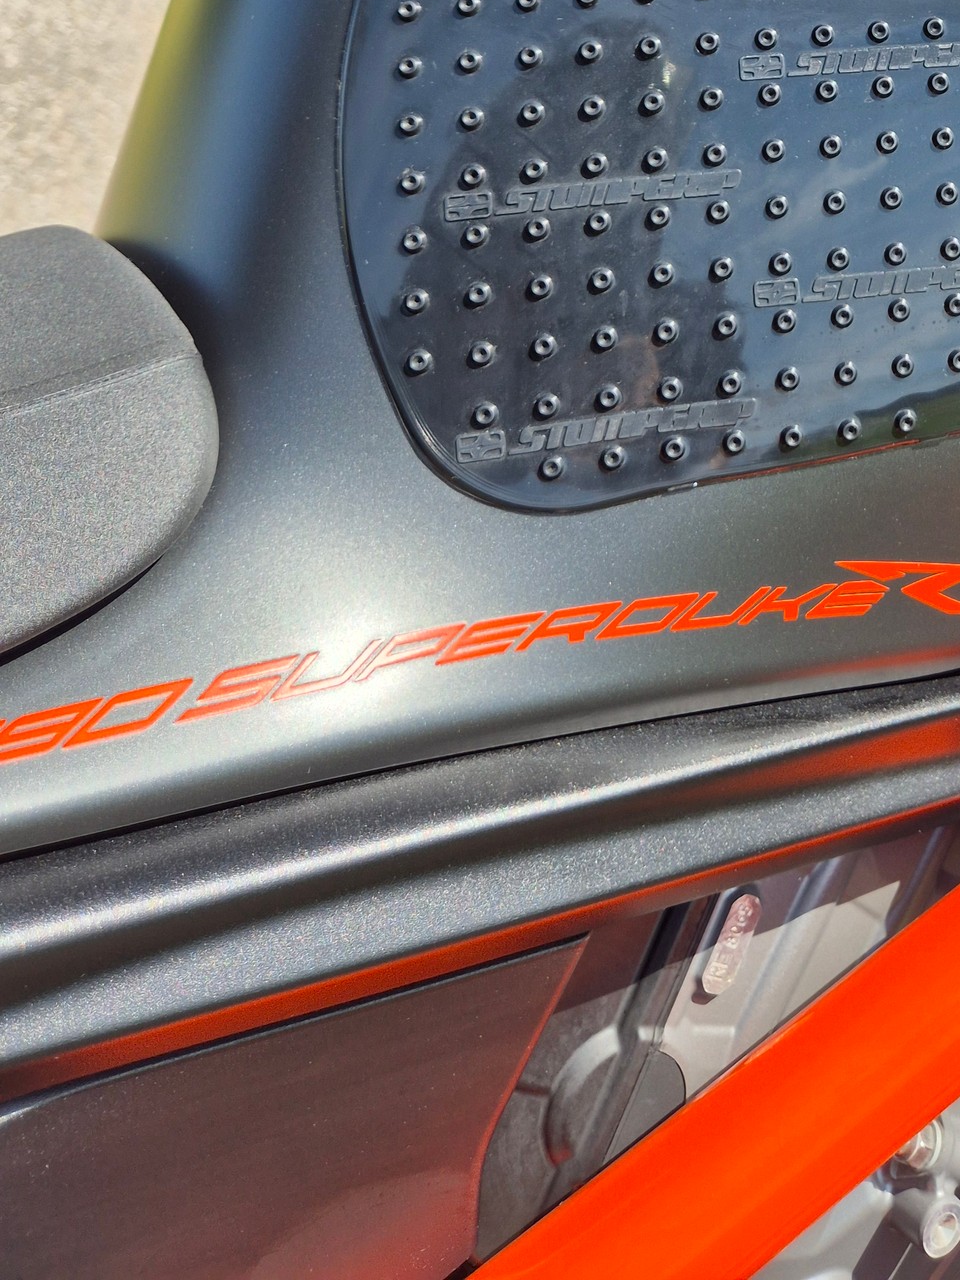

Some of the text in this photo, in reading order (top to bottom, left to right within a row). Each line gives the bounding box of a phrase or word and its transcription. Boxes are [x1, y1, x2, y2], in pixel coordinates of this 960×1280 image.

[494, 169, 742, 216] STOMPGRIP
[509, 398, 757, 456] STOMPGRIP
[0, 677, 193, 765] 90
